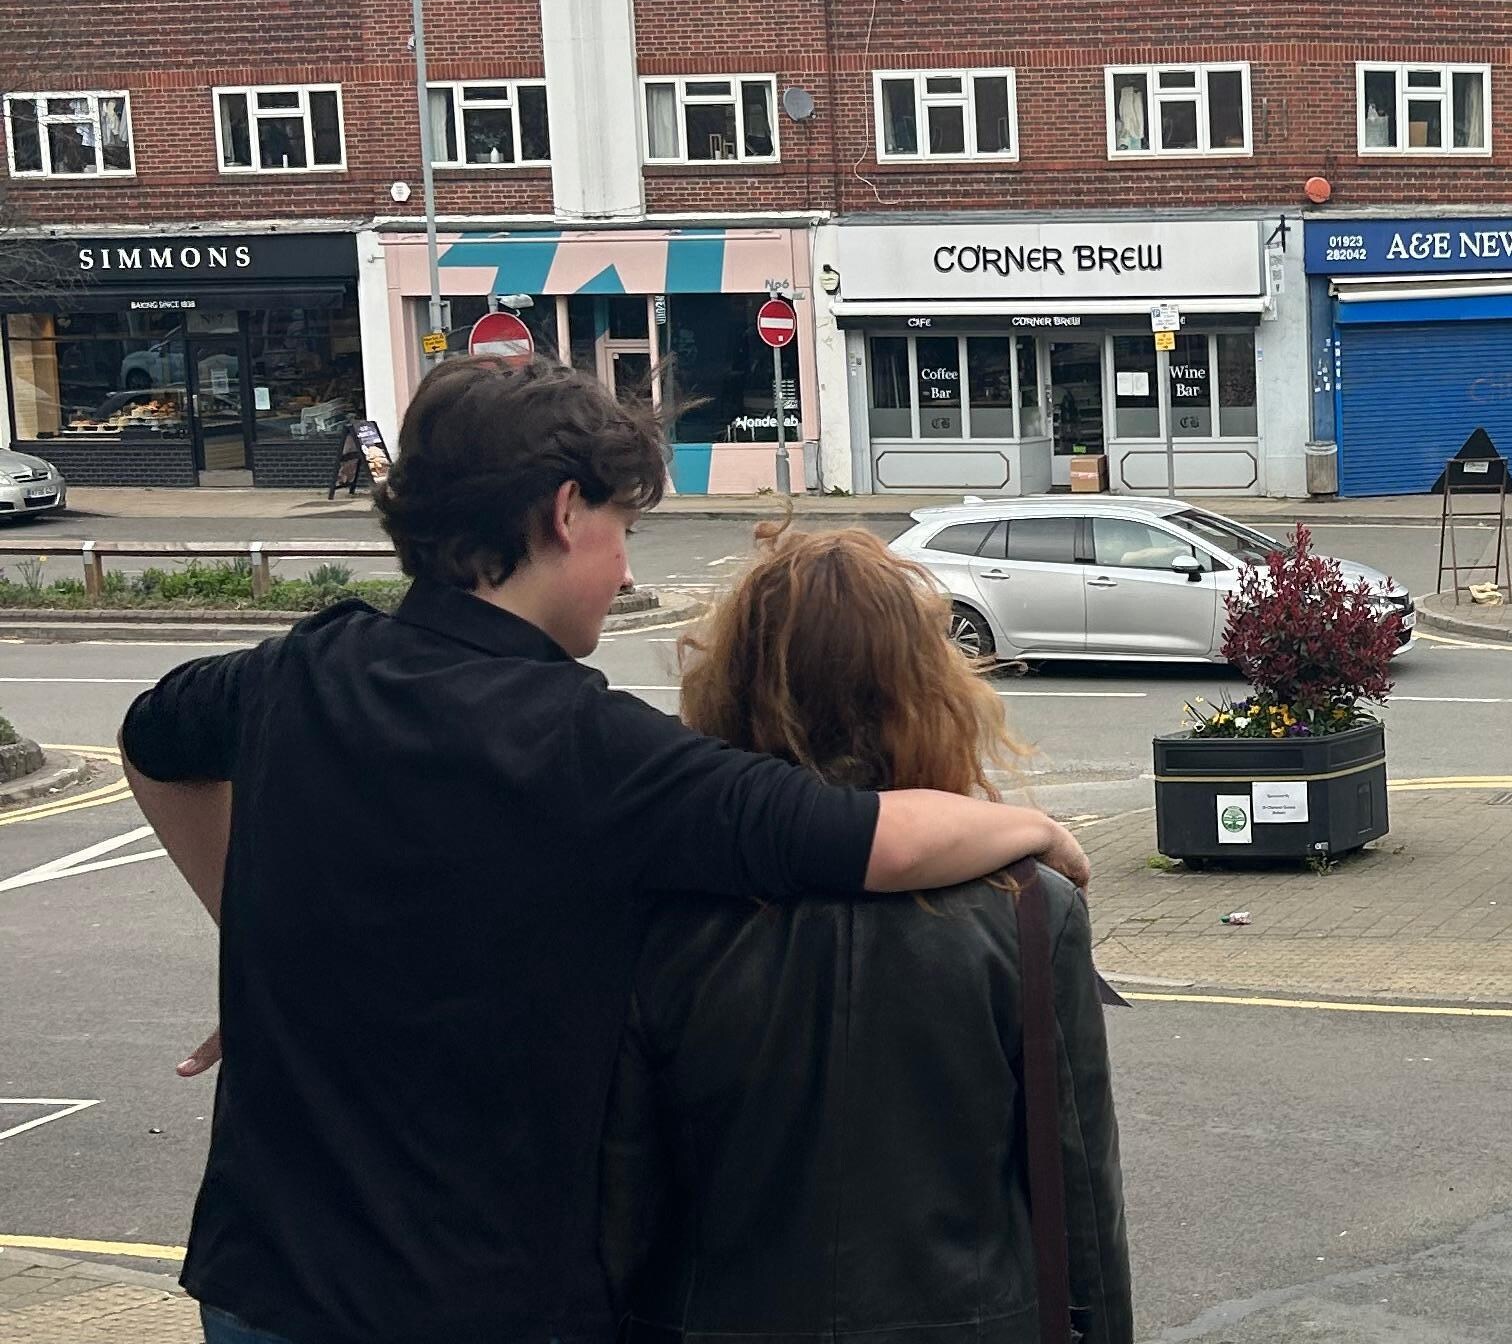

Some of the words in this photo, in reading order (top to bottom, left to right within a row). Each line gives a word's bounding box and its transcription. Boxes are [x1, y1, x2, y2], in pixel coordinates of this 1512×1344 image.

[1329, 236, 1364, 247] 01923
[1386, 233, 1452, 259] A&E
[79, 247, 251, 270] SIMMONS
[933, 245, 1065, 277] CORNER
[1072, 244, 1162, 275] BREW
[1326, 249, 1367, 260] 282042
[1012, 317, 1052, 327] CORNER
[921, 368, 959, 380] Coffee
[1169, 365, 1206, 379] Wine
[930, 388, 952, 399] Bar
[1176, 383, 1200, 397] Bar
